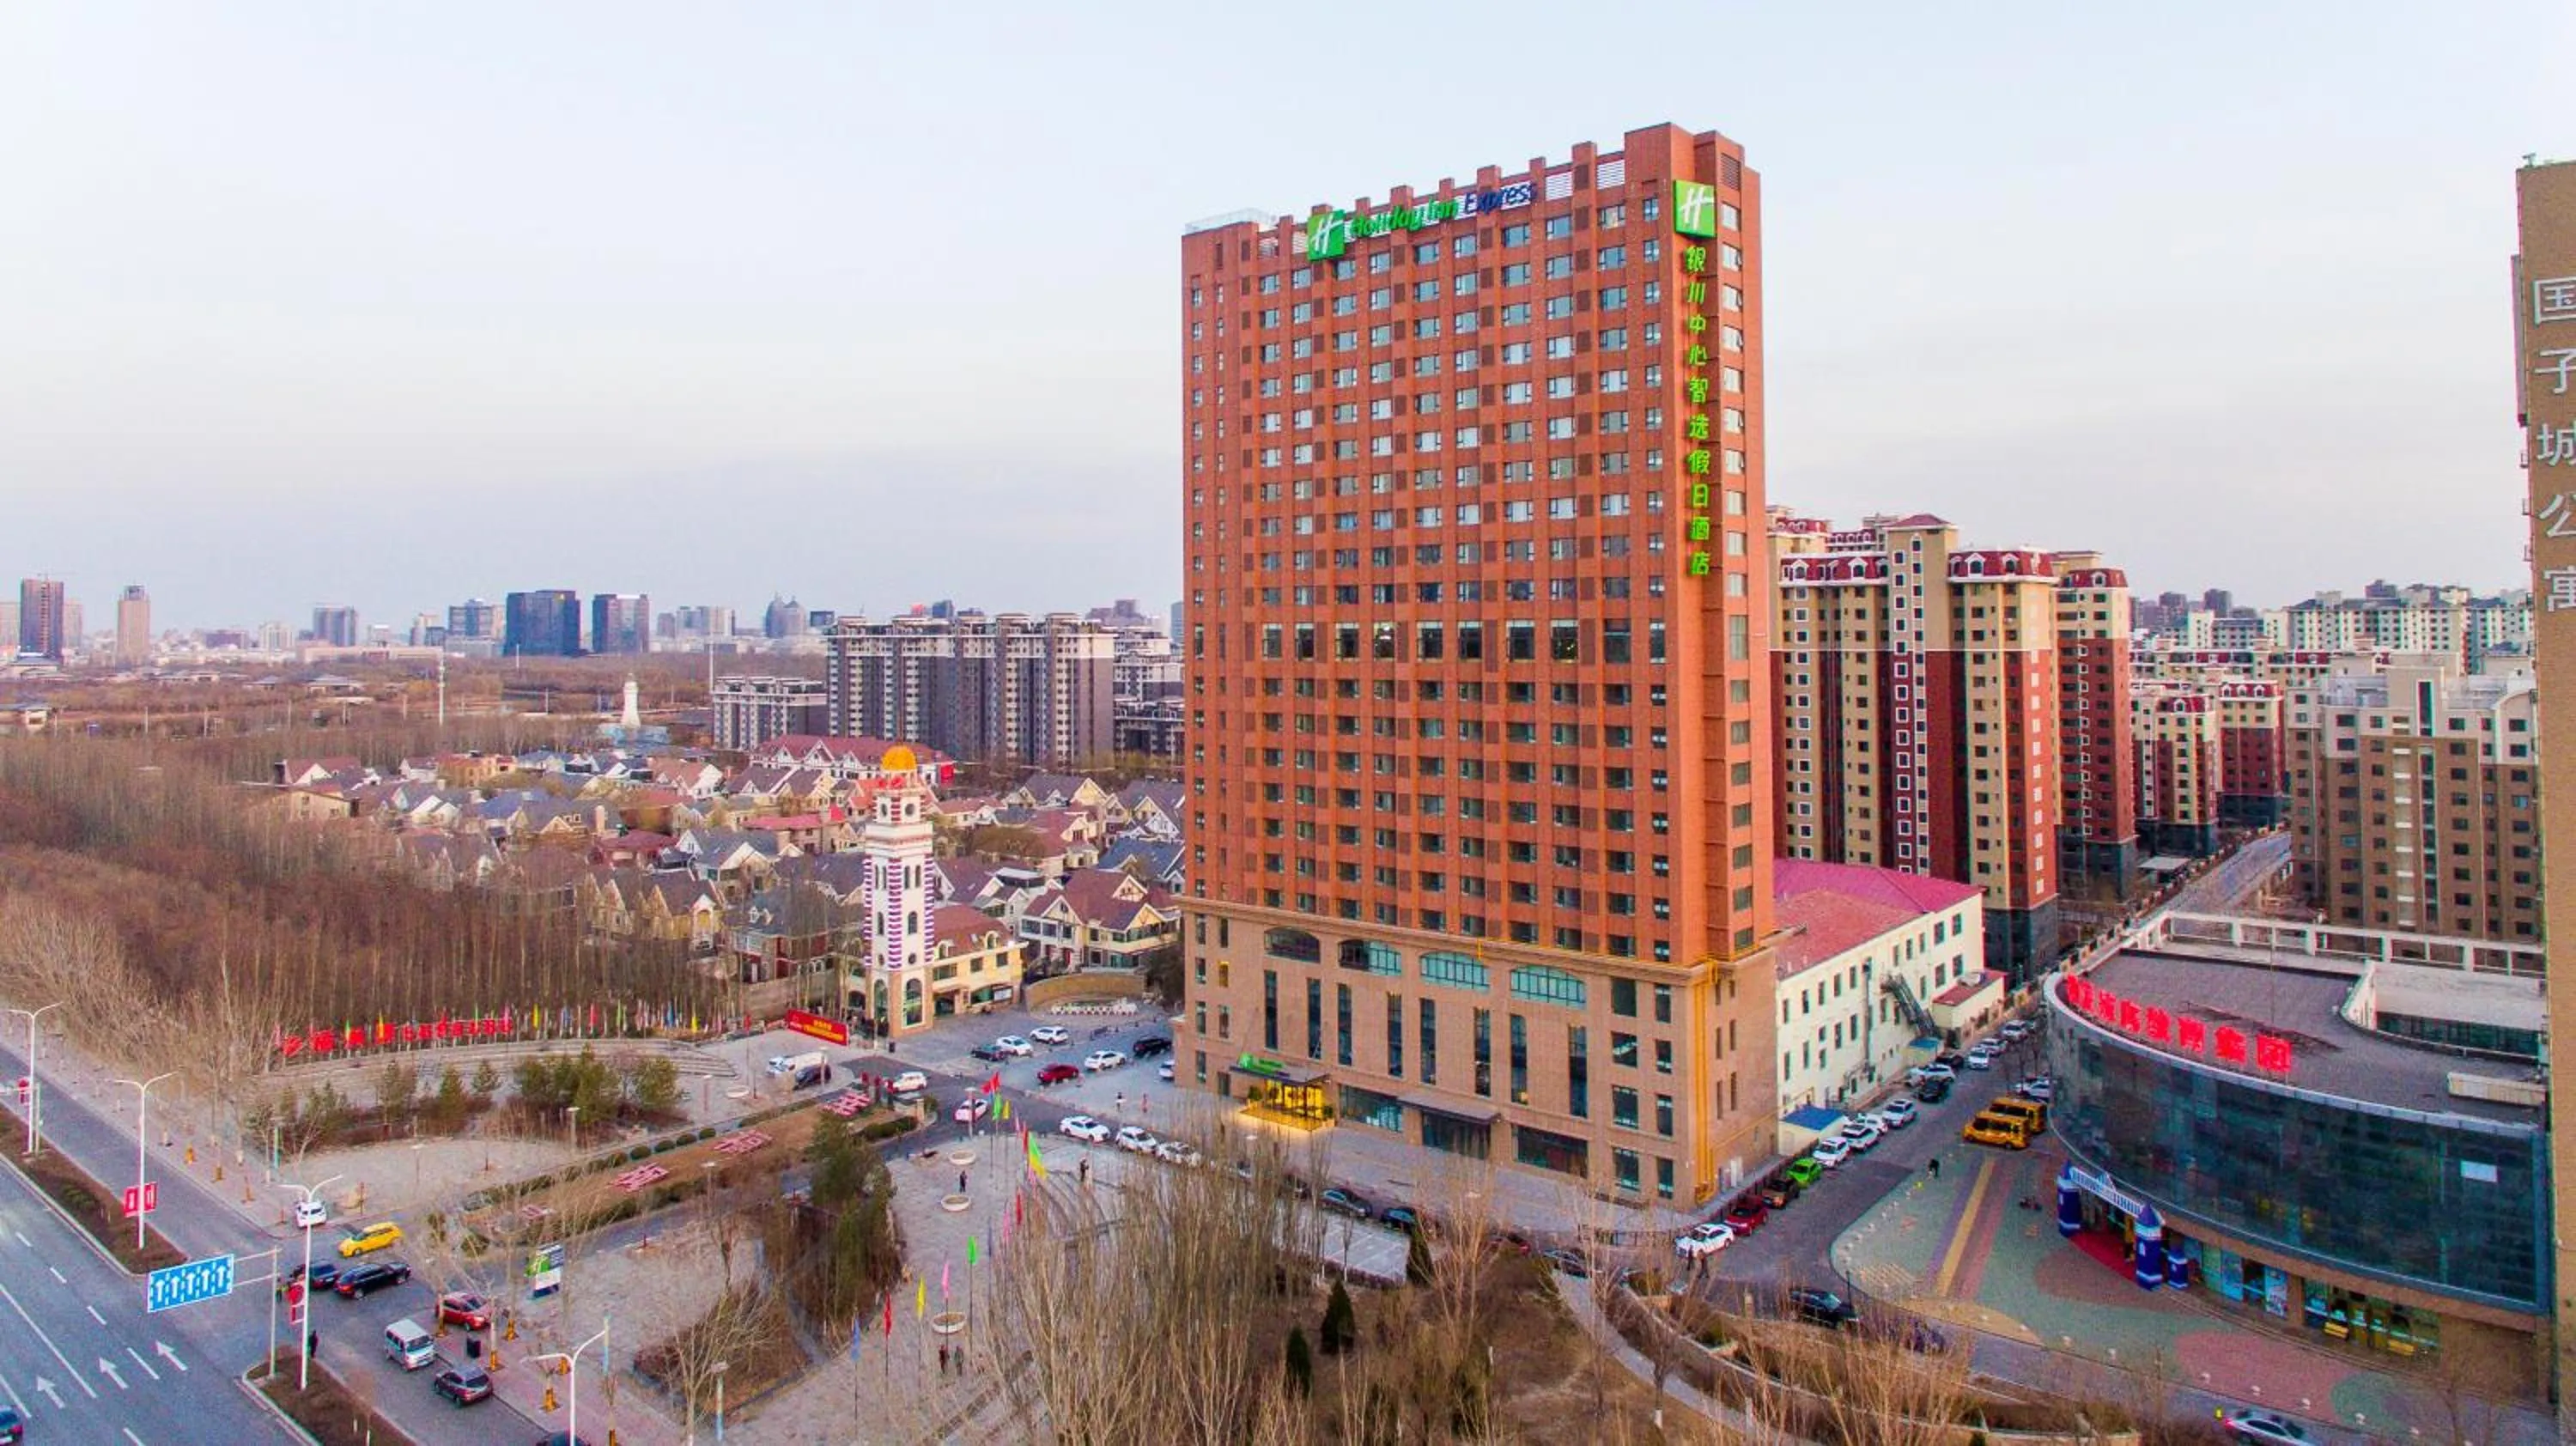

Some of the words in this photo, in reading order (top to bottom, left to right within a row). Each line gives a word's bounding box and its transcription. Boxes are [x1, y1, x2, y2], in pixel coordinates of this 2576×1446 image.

[1351, 204, 1423, 237] Holiday
[1426, 199, 1459, 221] Inn
[1463, 183, 1536, 214] Express
[1686, 246, 1709, 576] 银川中心智选假日酒店
